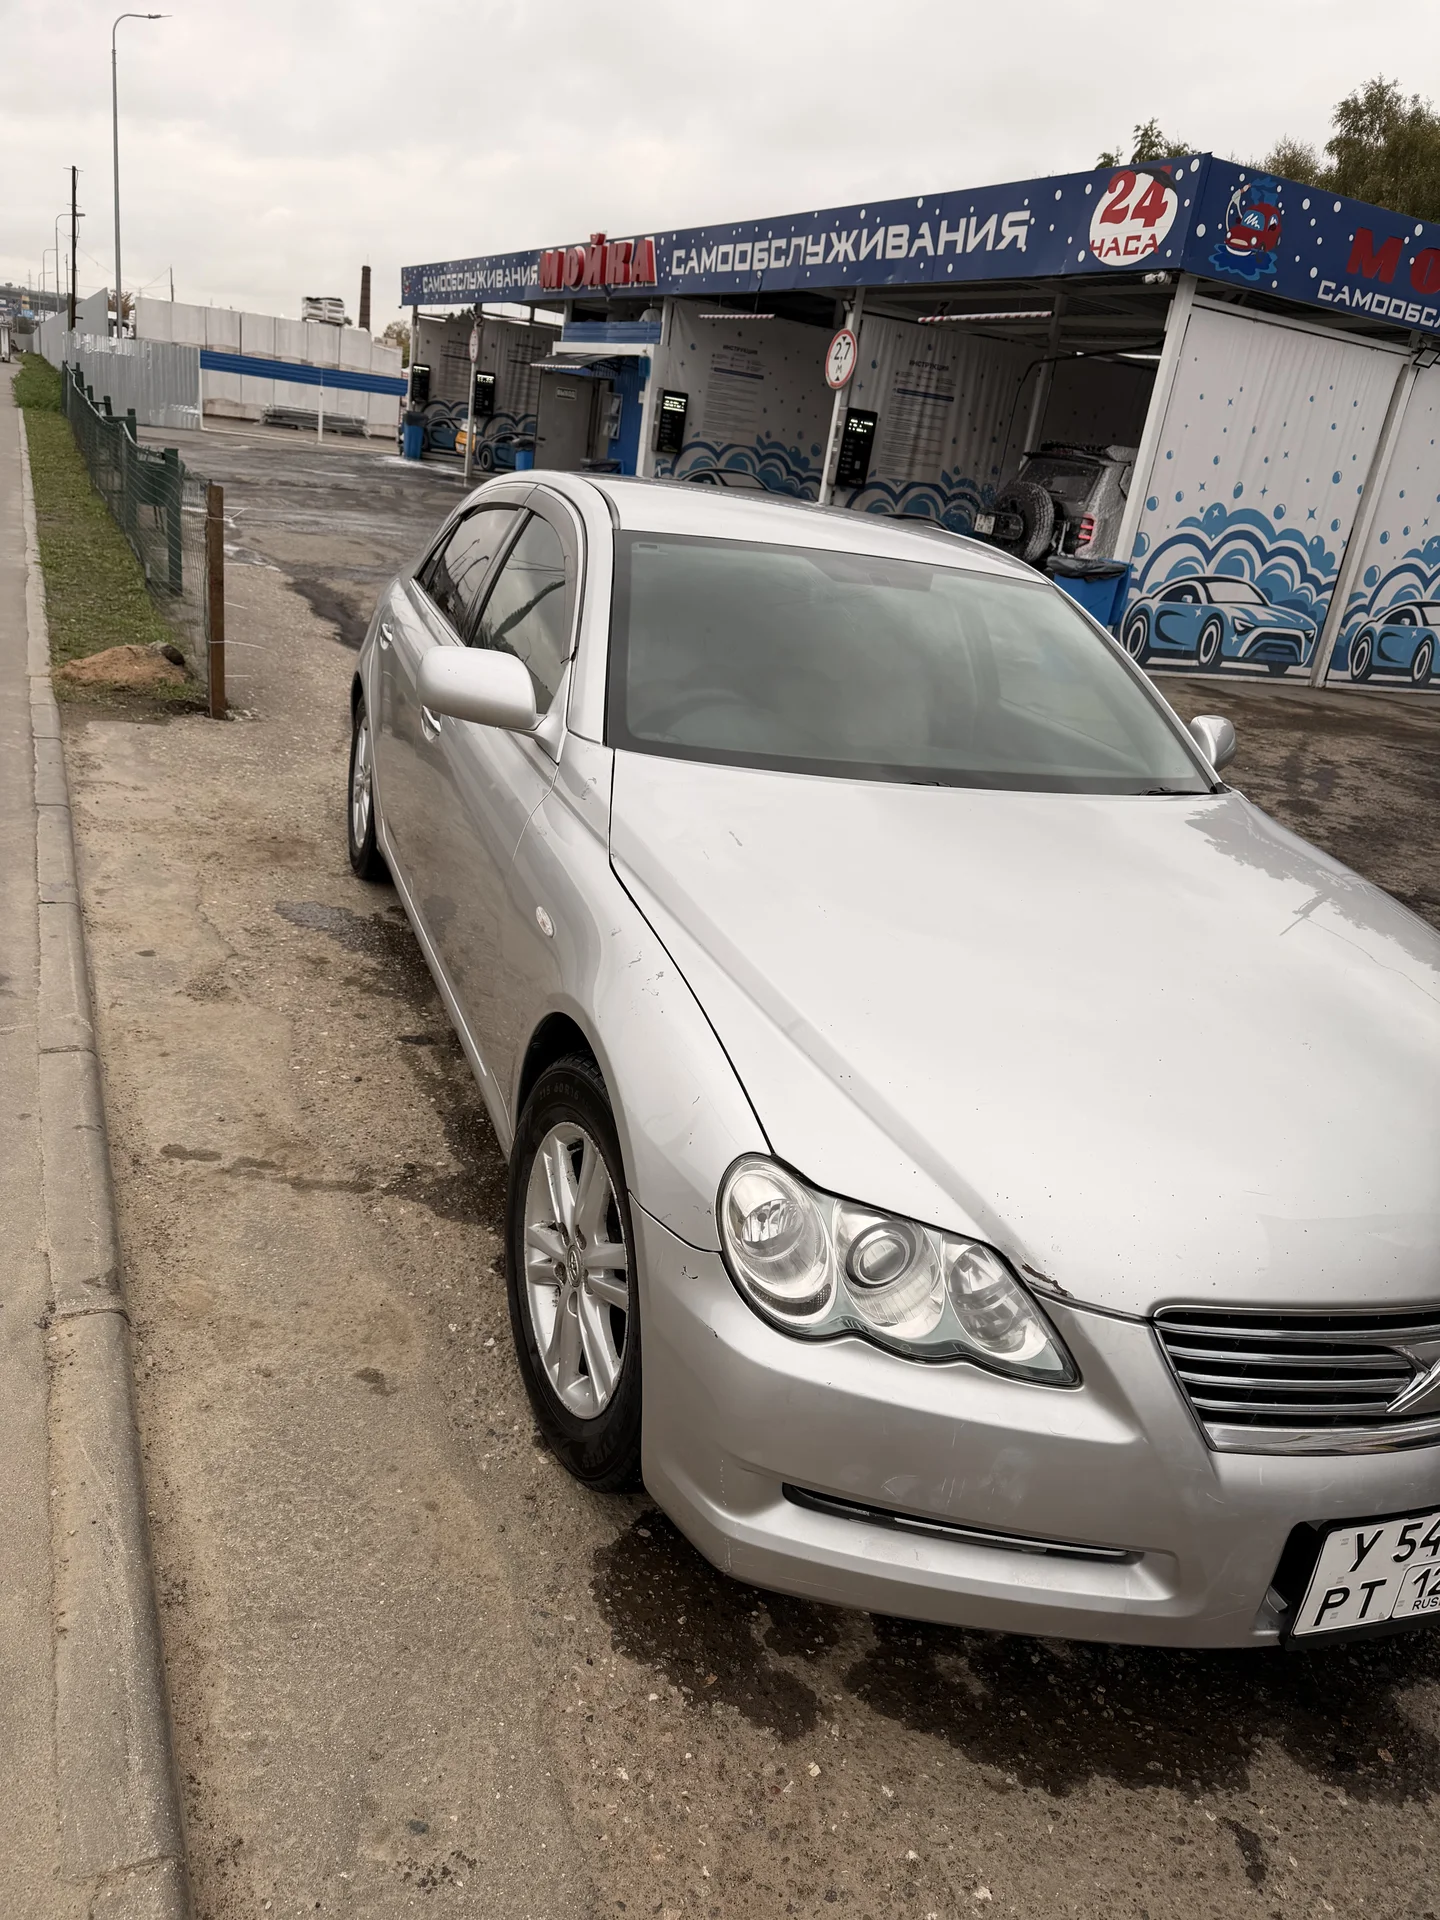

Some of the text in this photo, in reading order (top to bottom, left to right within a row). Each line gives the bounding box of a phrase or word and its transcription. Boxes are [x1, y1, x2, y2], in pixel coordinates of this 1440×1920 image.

[1099, 165, 1172, 228] 24
[540, 233, 657, 291] МОЙКА
[671, 209, 1031, 276] САМООБСЛУЖИВАНИЯ
[1090, 233, 1159, 257] ЧАСА
[422, 265, 538, 293] САМООБСЛУЖИВАНИЯ
[1317, 280, 1440, 328] САМООБС
[834, 341, 852, 363] 2,7
[1312, 1578, 1387, 1627] РТ
[1411, 1596, 1439, 1611] RUS
